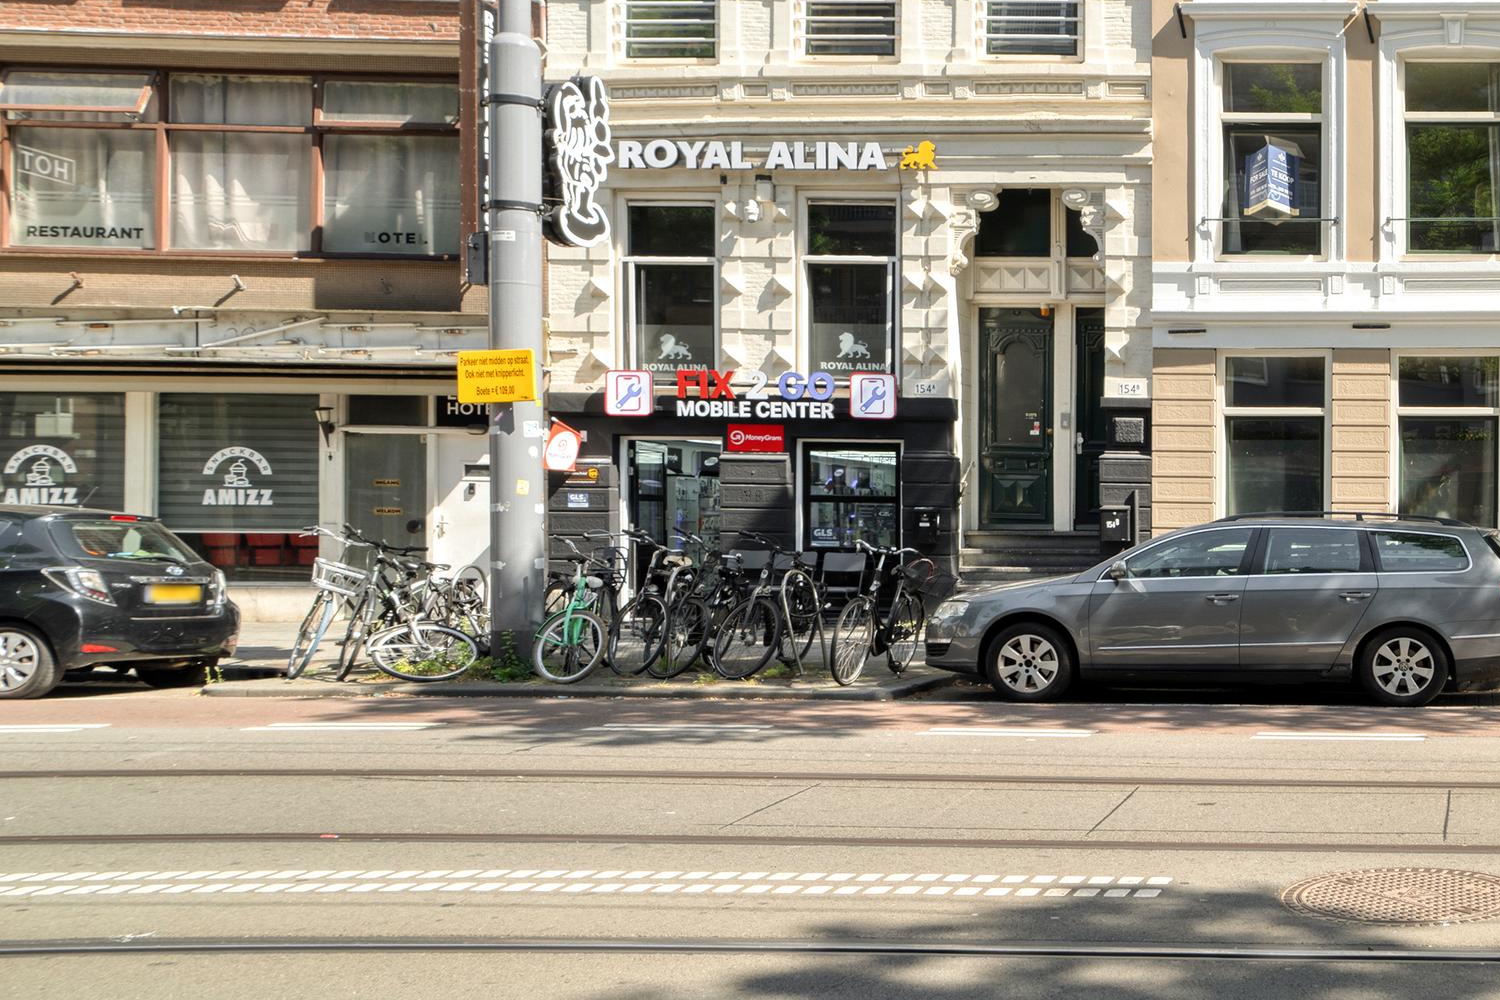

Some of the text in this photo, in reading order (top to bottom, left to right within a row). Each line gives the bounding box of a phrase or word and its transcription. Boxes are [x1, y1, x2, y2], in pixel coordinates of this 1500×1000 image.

[618, 139, 887, 171] ROYAL ALINA
[27, 226, 144, 239] RESTAURANT
[479, 356, 488, 365] niet
[489, 355, 506, 365] midden
[507, 357, 513, 366] op
[642, 363, 707, 372] ROYAL ALINA
[820, 361, 887, 371] ROYAL ALINA
[676, 370, 836, 400] FIX 2 GO
[676, 400, 835, 419] MOBILE CENTER
[745, 434, 782, 442] MoneyGram
[205, 448, 269, 472] SNACKBAR
[4, 487, 78, 505] AMIZZ
[202, 489, 273, 505] AMIZZ
[813, 528, 833, 537] GLS
